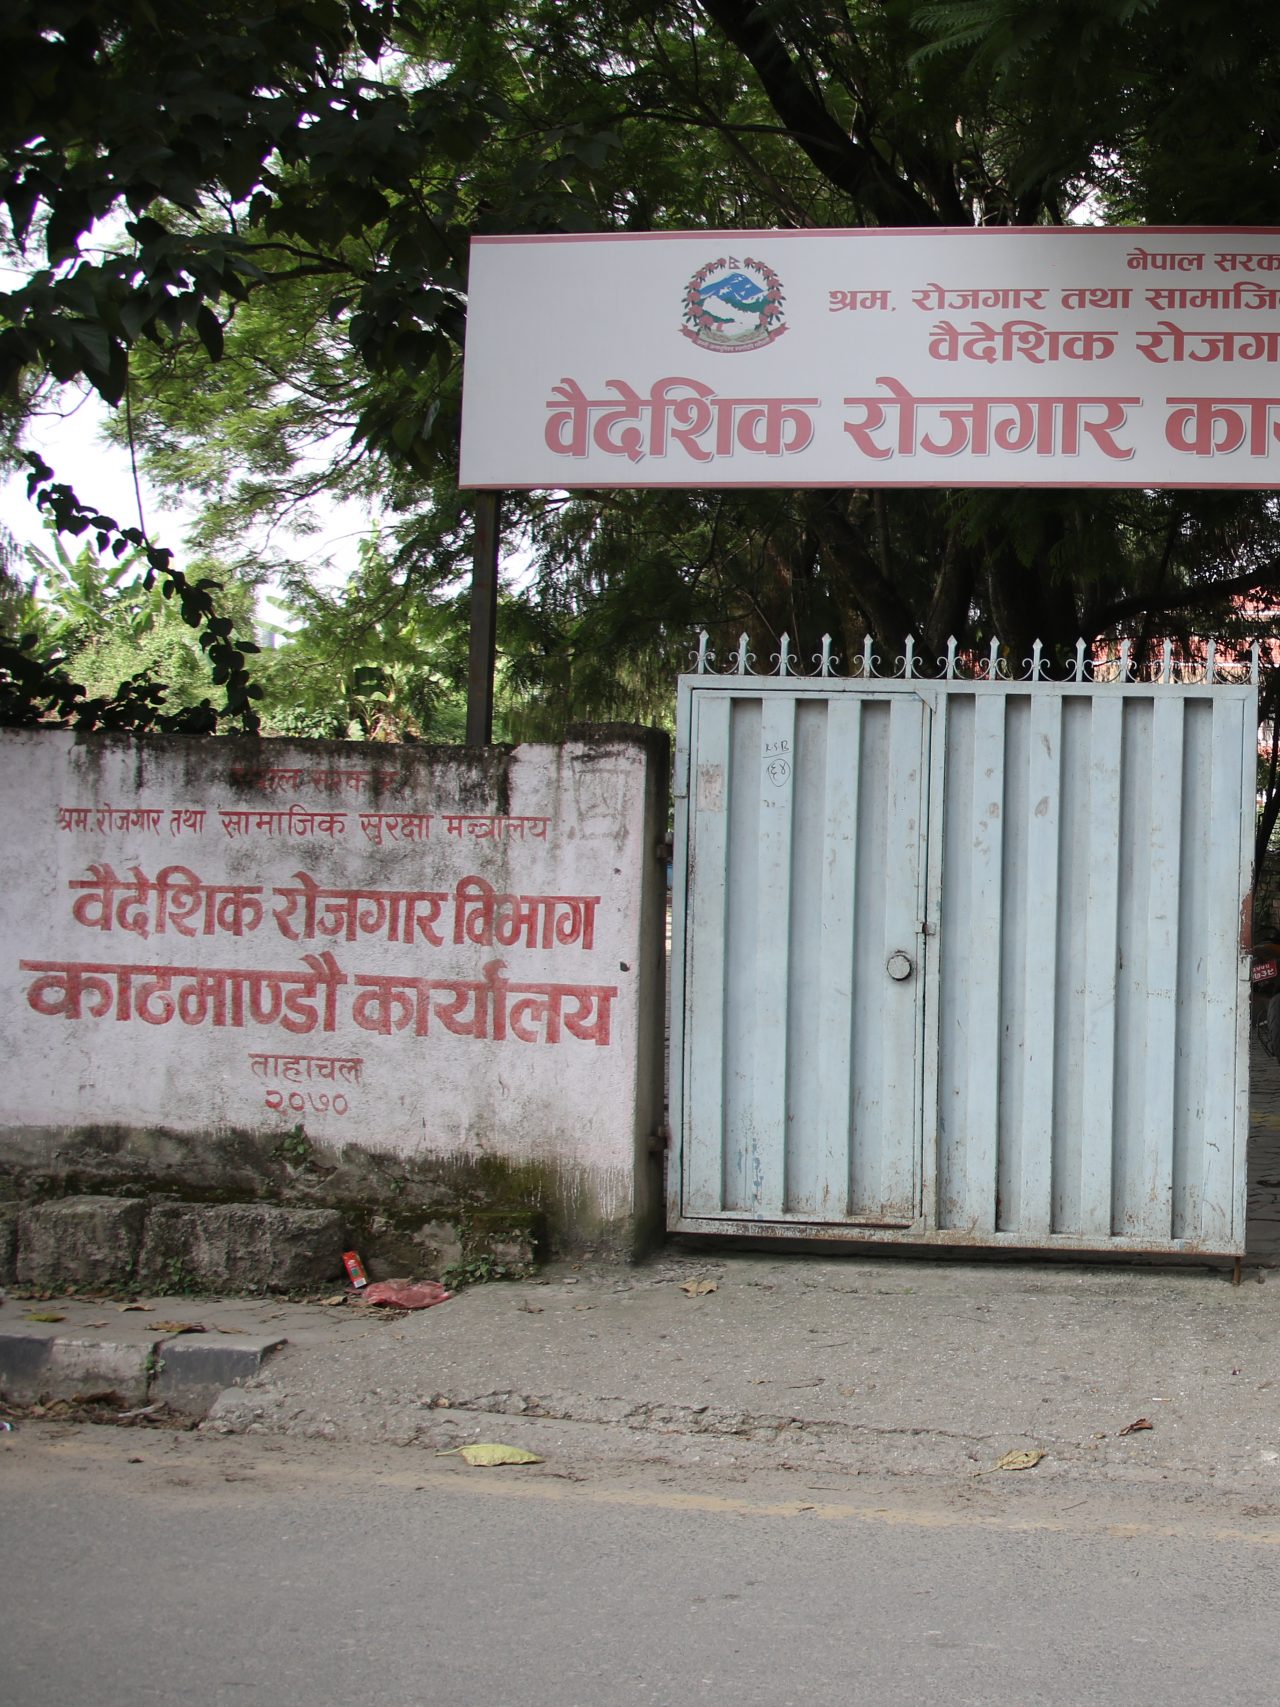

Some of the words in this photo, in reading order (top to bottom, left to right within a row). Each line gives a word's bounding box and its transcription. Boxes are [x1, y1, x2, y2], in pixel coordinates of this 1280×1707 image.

[1128, 247, 1203, 271] नेपाल
[830, 290, 897, 313] श्रम,
[913, 283, 1049, 310] रोजगार
[1061, 288, 1132, 310] तथा
[928, 320, 1119, 364] वैदेशिक
[545, 377, 820, 461] वैदेशिक
[844, 376, 1142, 460] रोजगार
[96, 803, 165, 836] रोजगार
[170, 809, 206, 837] तथा
[219, 804, 348, 838] सामाजिक
[359, 813, 434, 845] सुरक्षा
[442, 815, 550, 841] मन्त्रालय
[69, 863, 264, 940] वैदेशिक
[272, 871, 449, 947] रोजगार
[454, 875, 601, 949] विभाग
[353, 959, 618, 1046] कार्यालय
[248, 1053, 363, 1084] ताहाचल
[265, 1089, 348, 1116] २०७०
